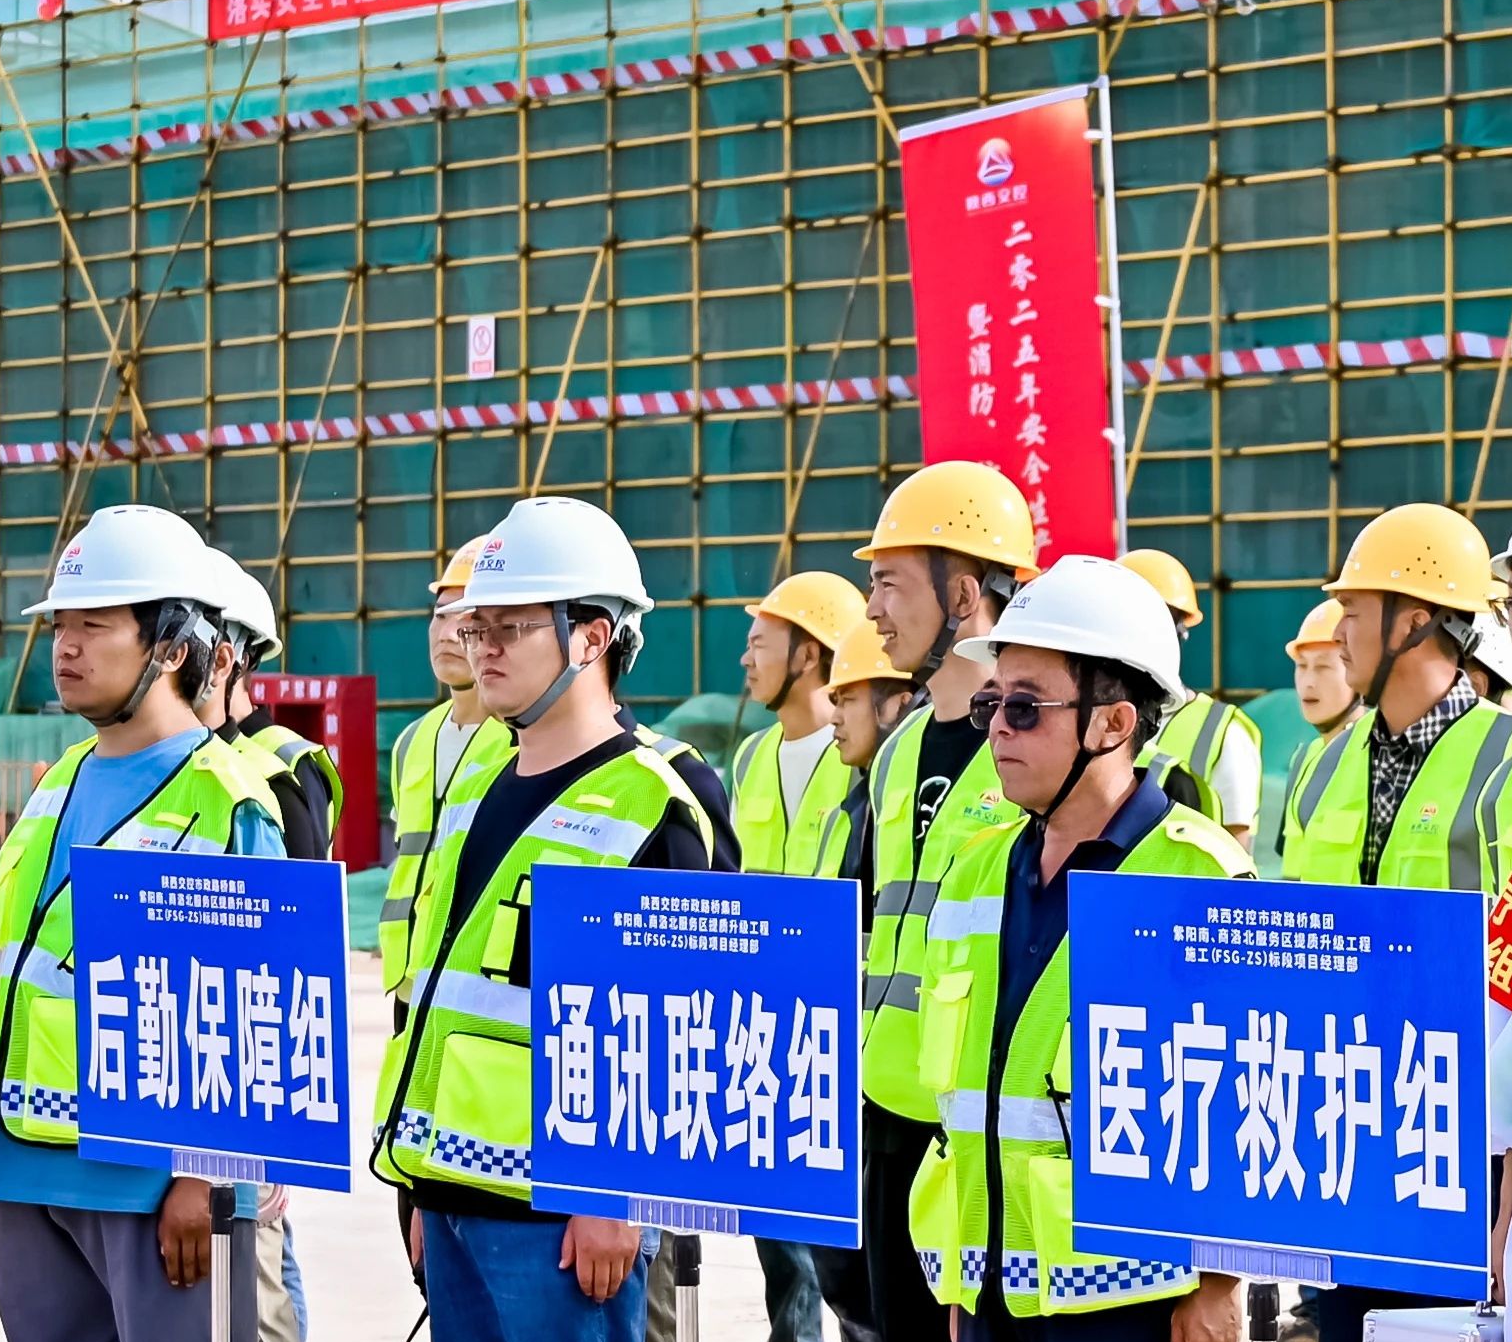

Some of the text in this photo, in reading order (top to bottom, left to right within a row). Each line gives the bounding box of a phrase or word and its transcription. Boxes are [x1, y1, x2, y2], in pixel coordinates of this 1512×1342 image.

[964, 301, 1002, 472] 暨消防、
[86, 954, 340, 1125] 后勤保障组
[543, 983, 845, 1173] 通讯联络组
[1087, 1000, 1468, 1212] 医疗救护组
